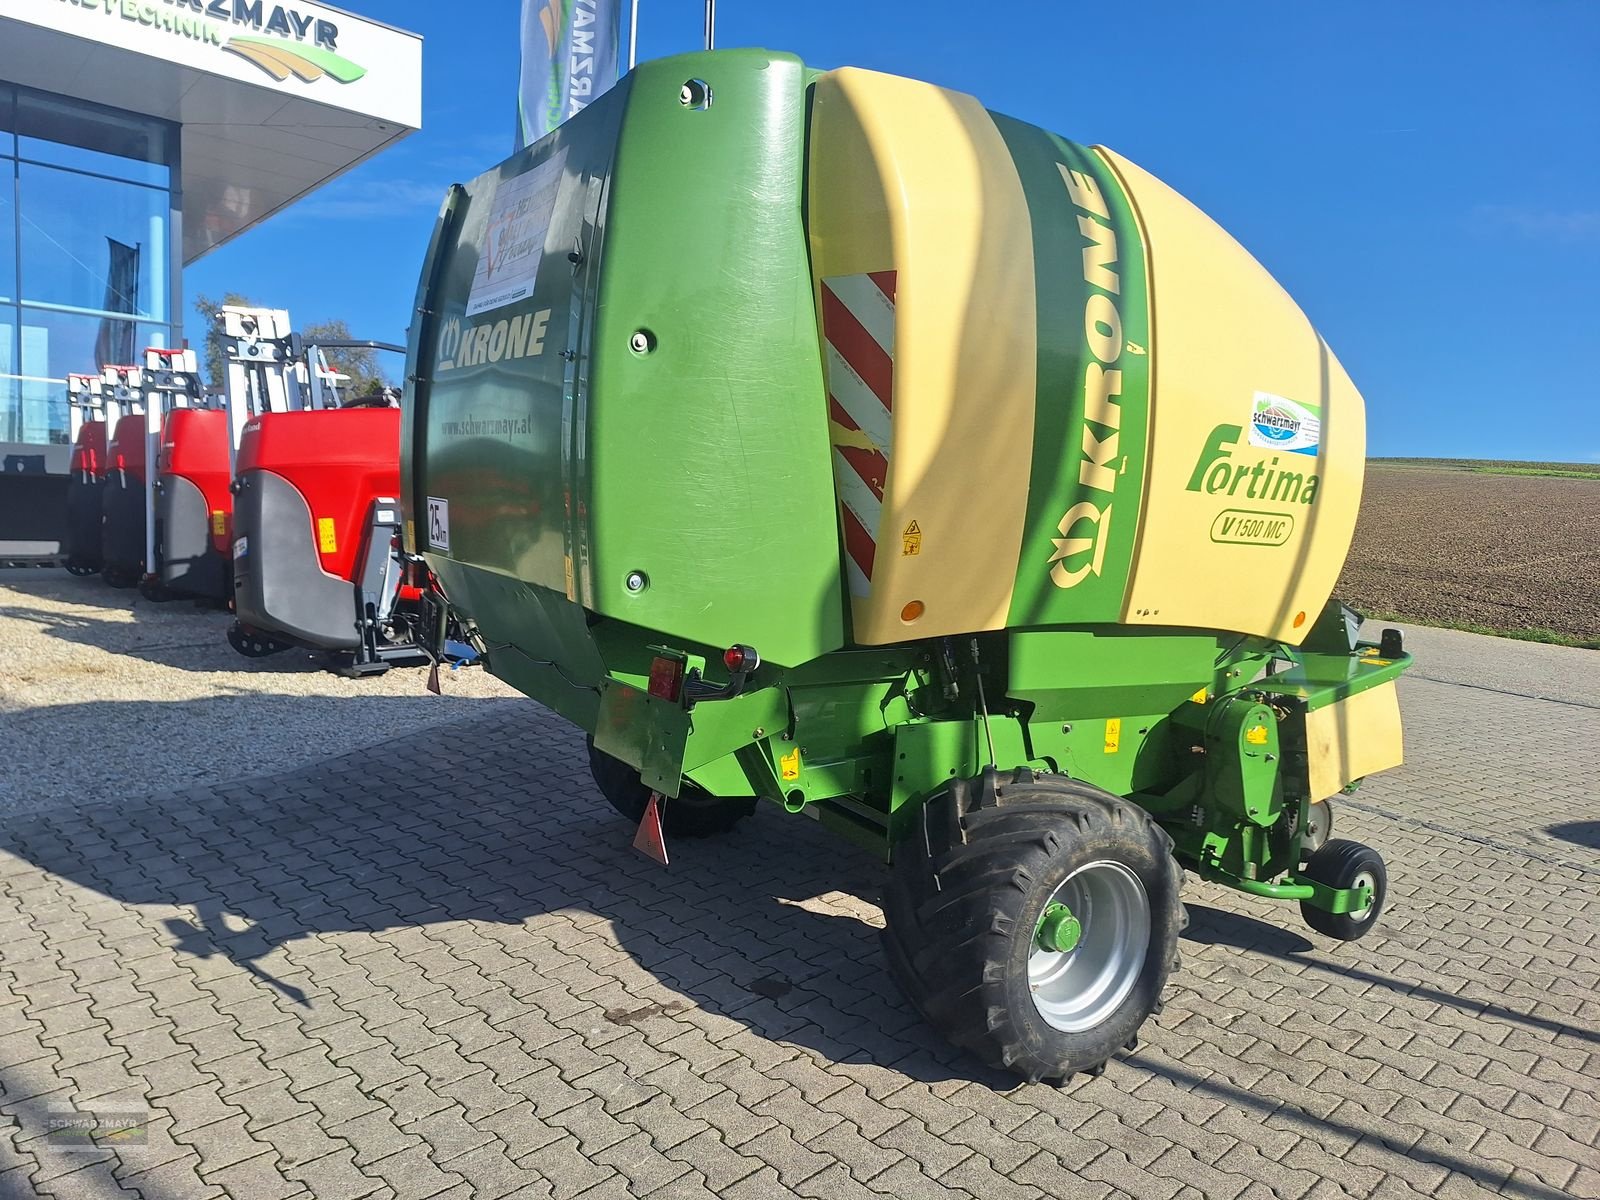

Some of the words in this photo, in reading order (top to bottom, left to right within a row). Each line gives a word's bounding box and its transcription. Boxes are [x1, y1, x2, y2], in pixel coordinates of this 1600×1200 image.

[456, 308, 551, 368] KRONE
[1056, 162, 1123, 493] KRONE
[442, 413, 532, 442] www.schwarzmayr.at
[1253, 411, 1301, 432] schwarzmayr
[1185, 423, 1320, 505] Fortima
[430, 503, 440, 542] 25
[1220, 516, 1236, 536] V
[1235, 518, 1264, 537] 1500
[1263, 520, 1286, 539] MC
